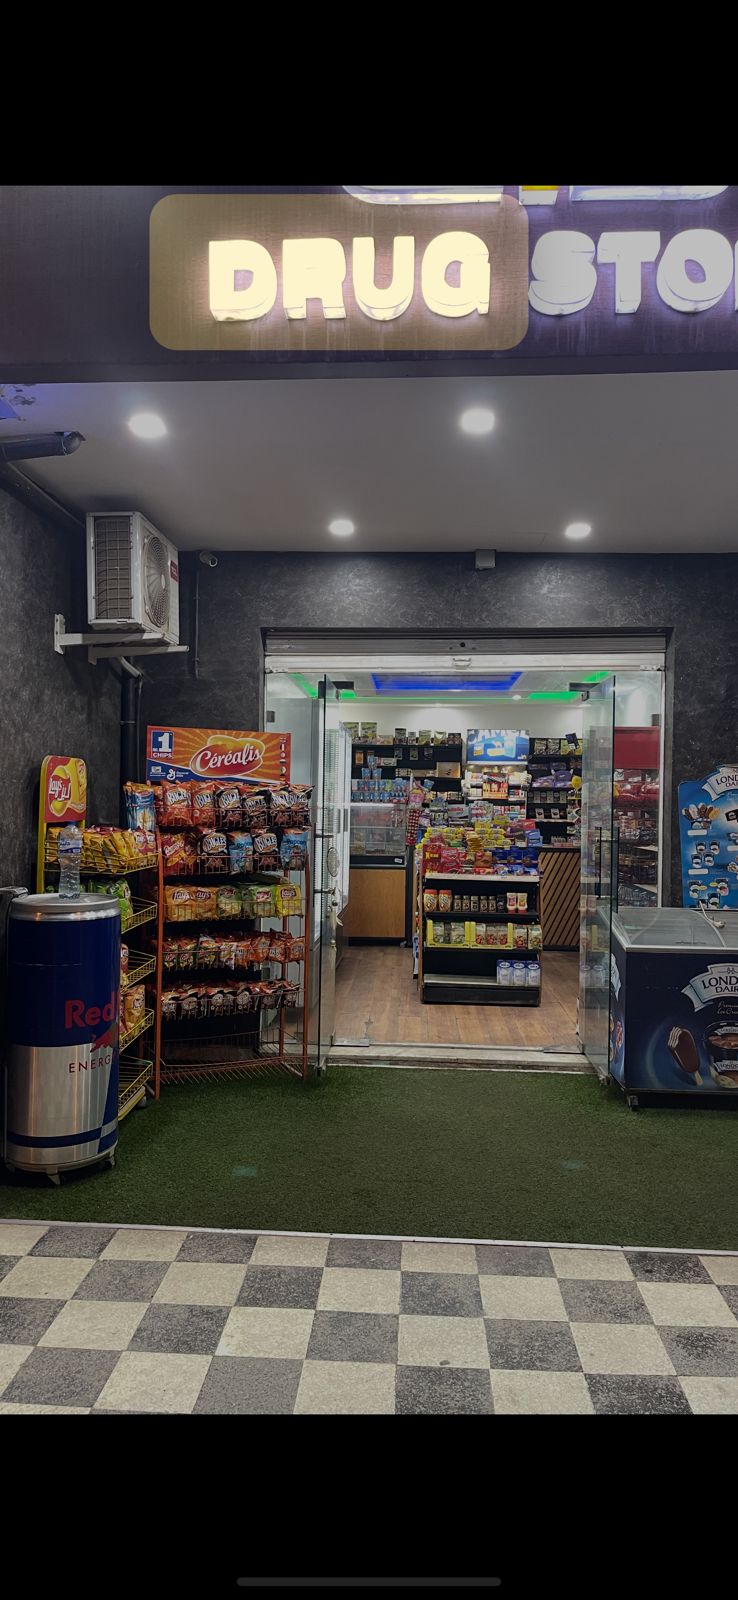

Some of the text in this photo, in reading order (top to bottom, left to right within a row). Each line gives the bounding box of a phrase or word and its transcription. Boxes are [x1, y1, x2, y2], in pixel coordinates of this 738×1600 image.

[208, 228, 738, 321] DRUG STO
[196, 743, 260, 771] Céréalis
[65, 991, 115, 1029] Red
[69, 1054, 112, 1073] ENERG
